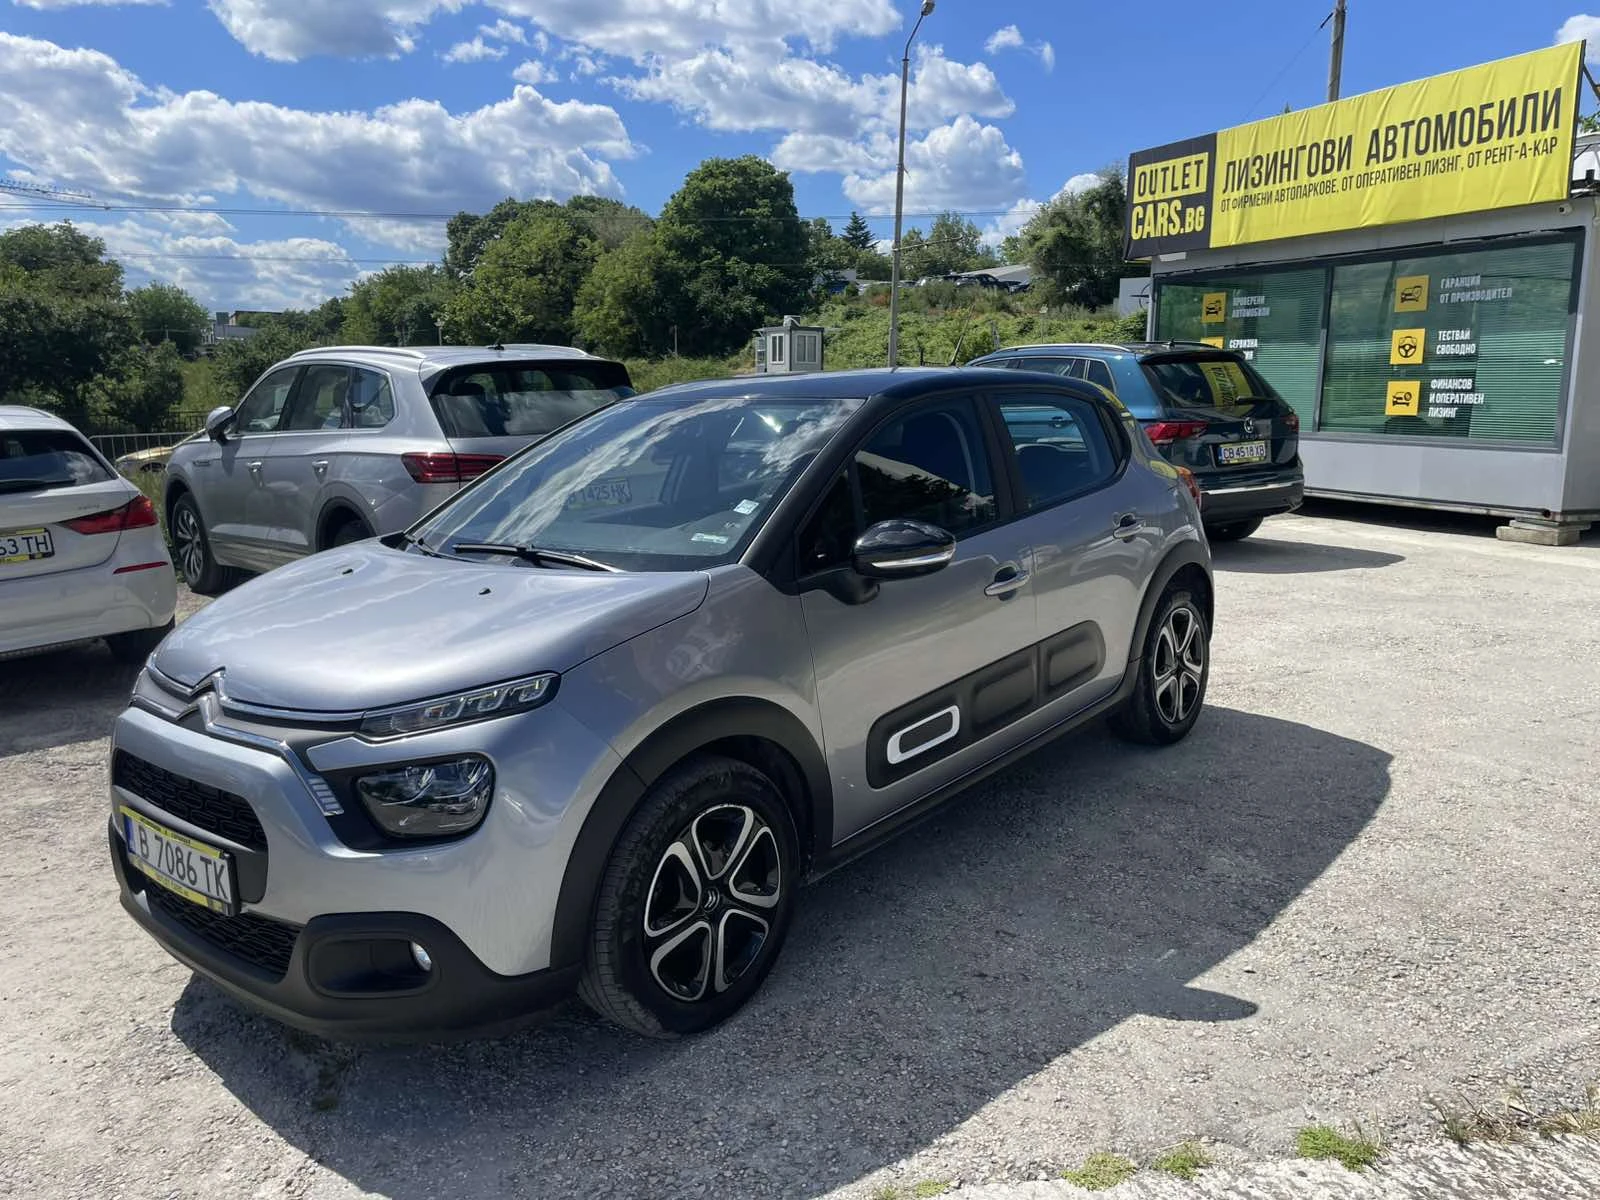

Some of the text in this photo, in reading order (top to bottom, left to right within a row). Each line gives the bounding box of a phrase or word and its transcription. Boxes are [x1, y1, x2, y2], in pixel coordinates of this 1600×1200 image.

[1222, 87, 1562, 194] ЛИЗИНГОВИ АВТОМОБИЛИ
[1137, 159, 1204, 197] OUTLET
[1220, 198, 1231, 213] ОТ
[1231, 191, 1273, 209] ФИРМЕНИ
[1342, 175, 1354, 191] ОТ
[1356, 162, 1421, 189] ОПЕРАТИВЕН
[1467, 150, 1482, 169] ОТ
[1484, 136, 1558, 166] РЕНТ-А-КАР
[1131, 200, 1206, 240] CARS.BG
[1440, 287, 1513, 304] ОТ ПРОИЗВОДИТЕЛ
[1438, 328, 1471, 341] ТЕСТВАЙ
[1436, 343, 1476, 356] СВОБОДНО
[1430, 378, 1473, 390] ФИНАНСОВ
[1435, 392, 1485, 405] ОПЕРАТИВЕН
[1428, 407, 1459, 418] ЛИЗИНГ
[1223, 447, 1235, 459] CB
[21, 535, 49, 553] TH
[138, 824, 150, 860] B
[154, 834, 198, 887] 7086
[200, 858, 228, 900] TK
